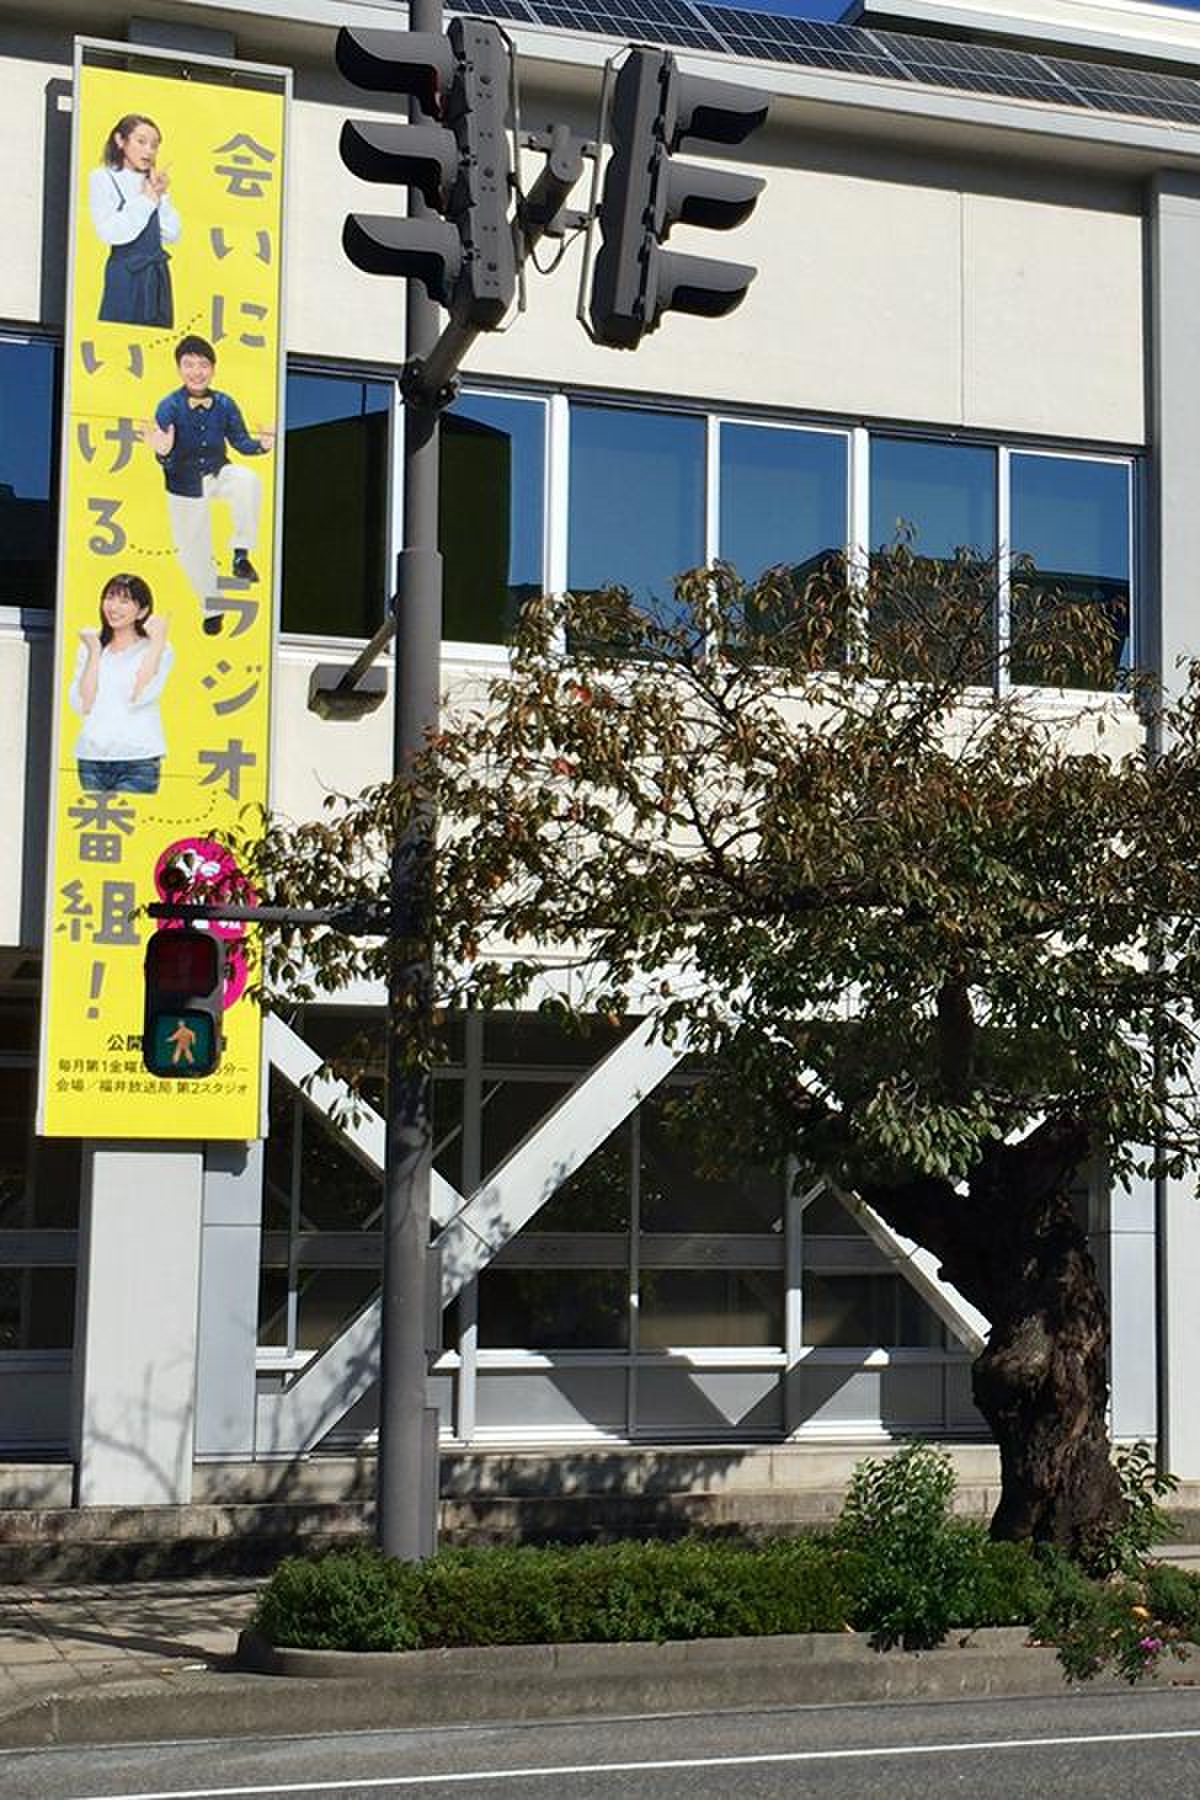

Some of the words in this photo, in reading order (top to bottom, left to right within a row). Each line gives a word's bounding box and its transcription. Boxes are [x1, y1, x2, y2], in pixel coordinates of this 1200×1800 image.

[211, 132, 276, 347] 会いに
[76, 340, 144, 556] いける
[198, 576, 263, 801] ラジオ
[54, 792, 142, 1020] 番組！
